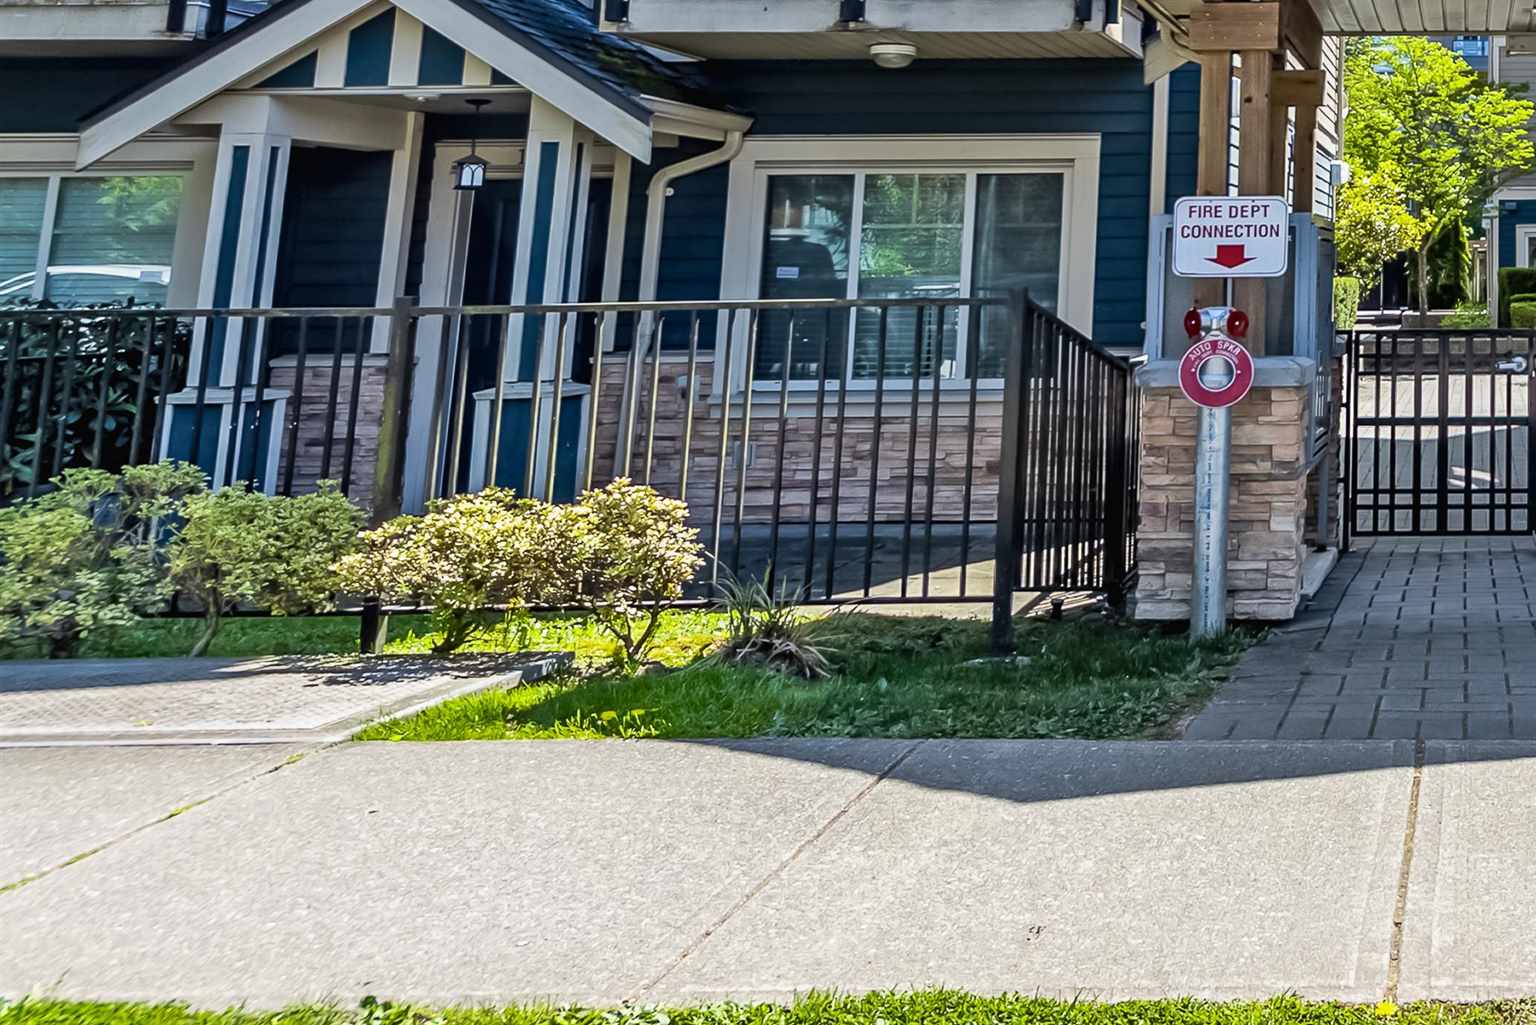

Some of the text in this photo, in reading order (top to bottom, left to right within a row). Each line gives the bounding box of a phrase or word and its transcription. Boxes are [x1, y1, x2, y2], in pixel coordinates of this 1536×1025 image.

[1188, 205, 1270, 218] FIRE DEPT
[1180, 224, 1280, 239] CONNECTION
[1188, 342, 1212, 361] AUTO
